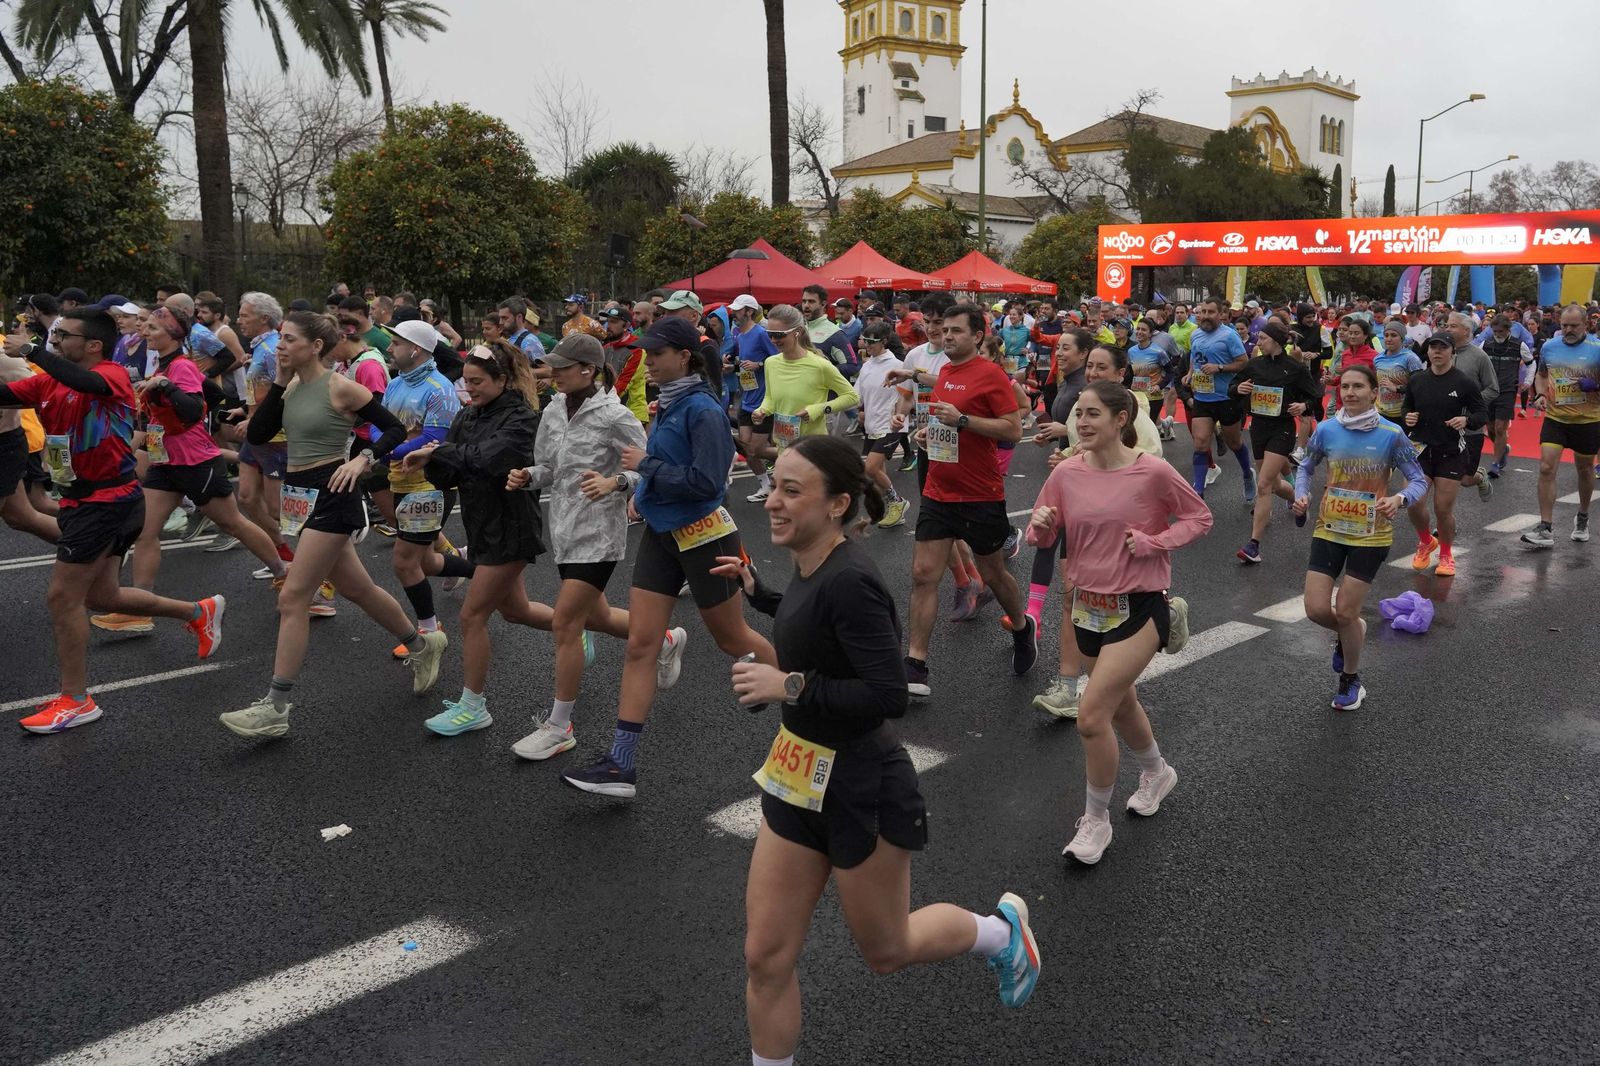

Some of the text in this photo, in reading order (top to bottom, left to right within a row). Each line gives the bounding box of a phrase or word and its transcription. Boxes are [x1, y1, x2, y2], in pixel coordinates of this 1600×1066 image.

[1366, 225, 1440, 241] maratón
[1532, 227, 1592, 246] HOKA
[1178, 239, 1216, 249] Sprinter
[1254, 235, 1298, 251] HOKA
[1383, 237, 1441, 253] sevilla
[1253, 392, 1278, 403] 15432
[928, 426, 951, 443] 19188
[283, 495, 309, 516] 20798
[399, 500, 438, 514] 21963
[1330, 498, 1368, 517] 15443
